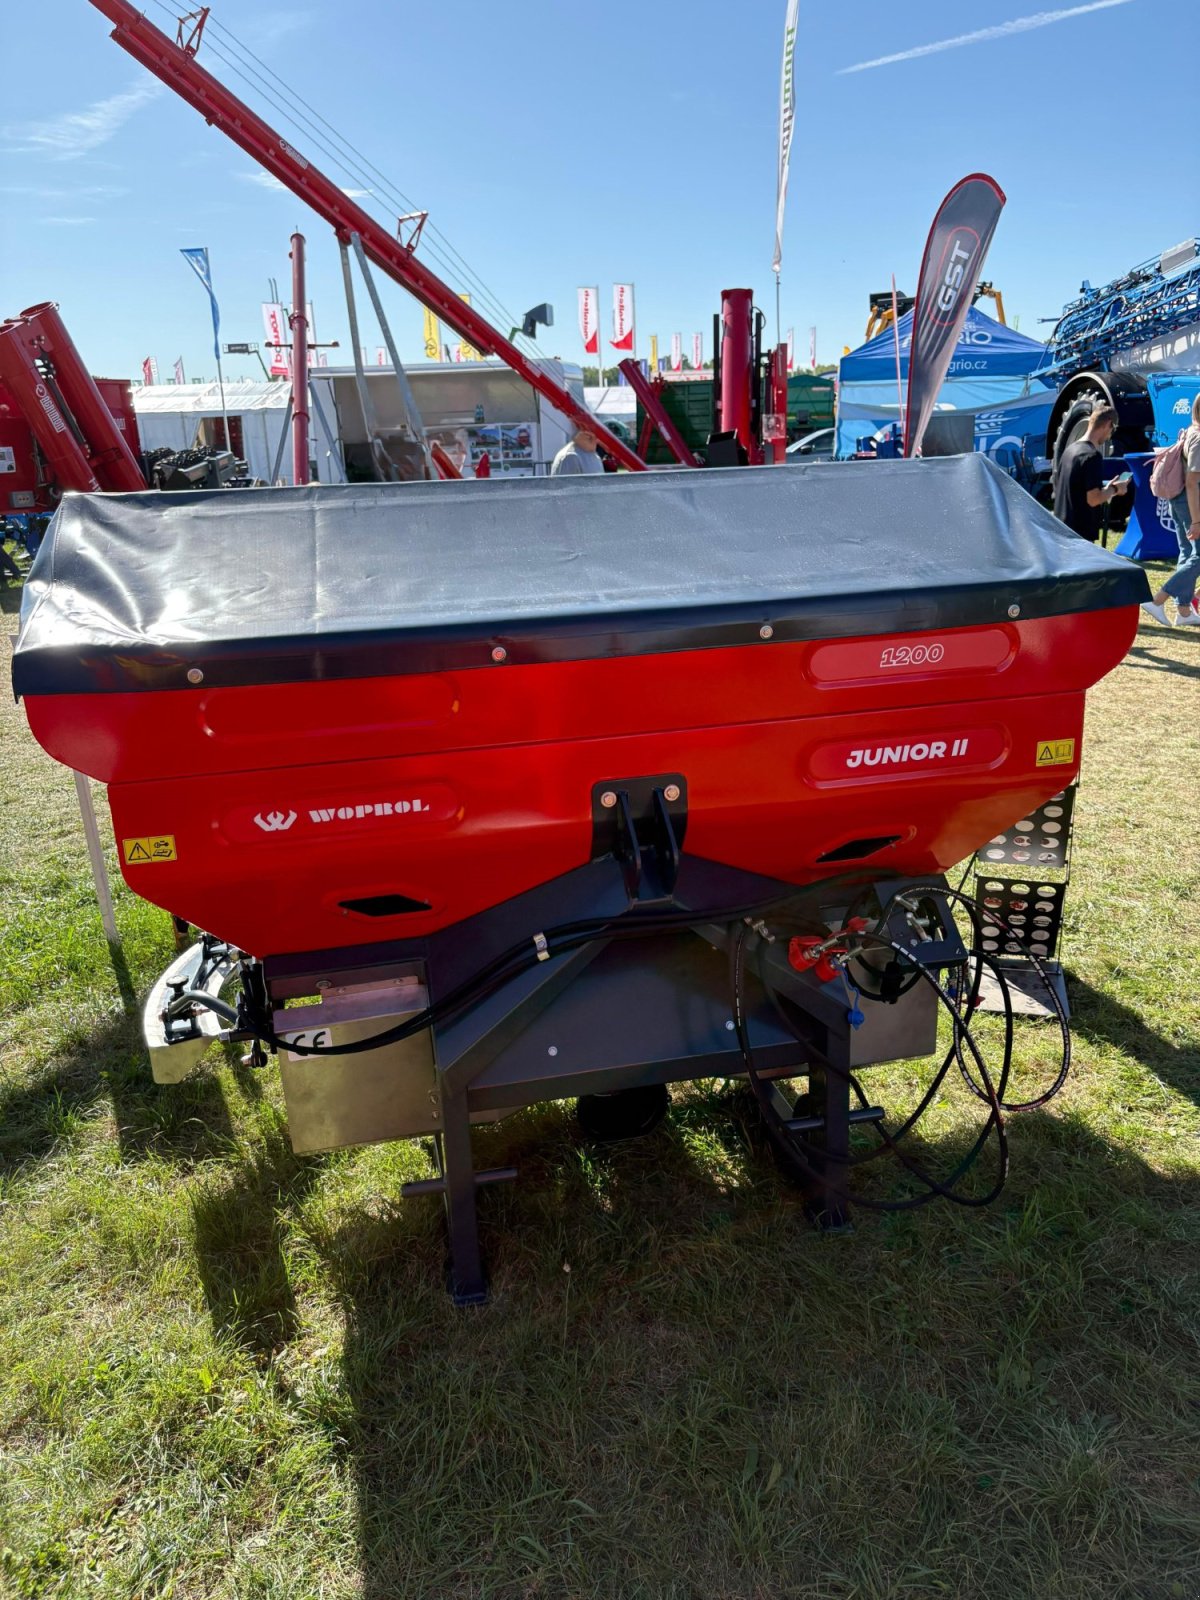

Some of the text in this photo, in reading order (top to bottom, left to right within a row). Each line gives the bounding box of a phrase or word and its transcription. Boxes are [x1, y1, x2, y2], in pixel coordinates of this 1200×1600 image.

[938, 240, 969, 311] GST
[879, 643, 944, 668] 1200
[846, 738, 969, 768] JUNIOR II
[309, 799, 430, 823] WOPROL
